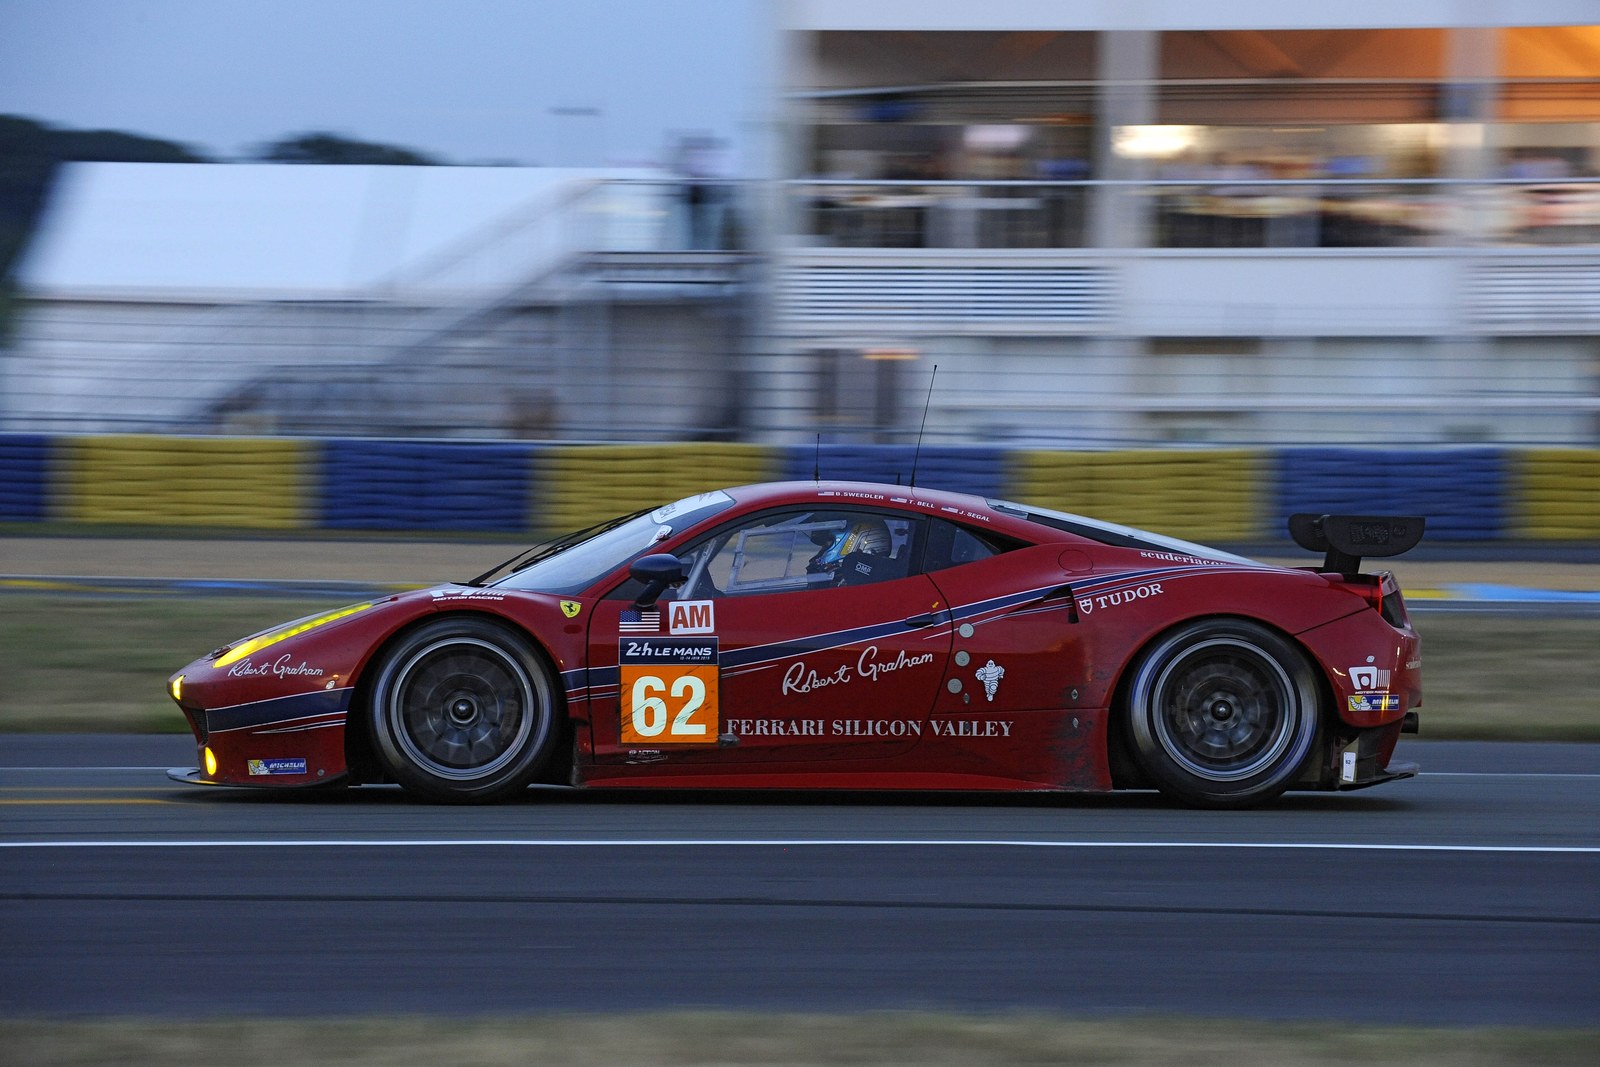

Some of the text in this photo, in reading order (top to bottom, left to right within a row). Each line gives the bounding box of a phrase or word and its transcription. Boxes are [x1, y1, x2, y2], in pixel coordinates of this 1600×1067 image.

[917, 501, 935, 509] BELL
[967, 512, 990, 522] SEGAL
[1096, 583, 1164, 609] TUDOR
[672, 604, 711, 629] AM
[654, 647, 672, 656] LE
[673, 647, 712, 656] MANS
[227, 653, 324, 679] Robert Graham
[782, 645, 933, 696] Robert Graham
[631, 675, 706, 736] 62
[726, 719, 1014, 737] FERRARI SILICON VALLEY
